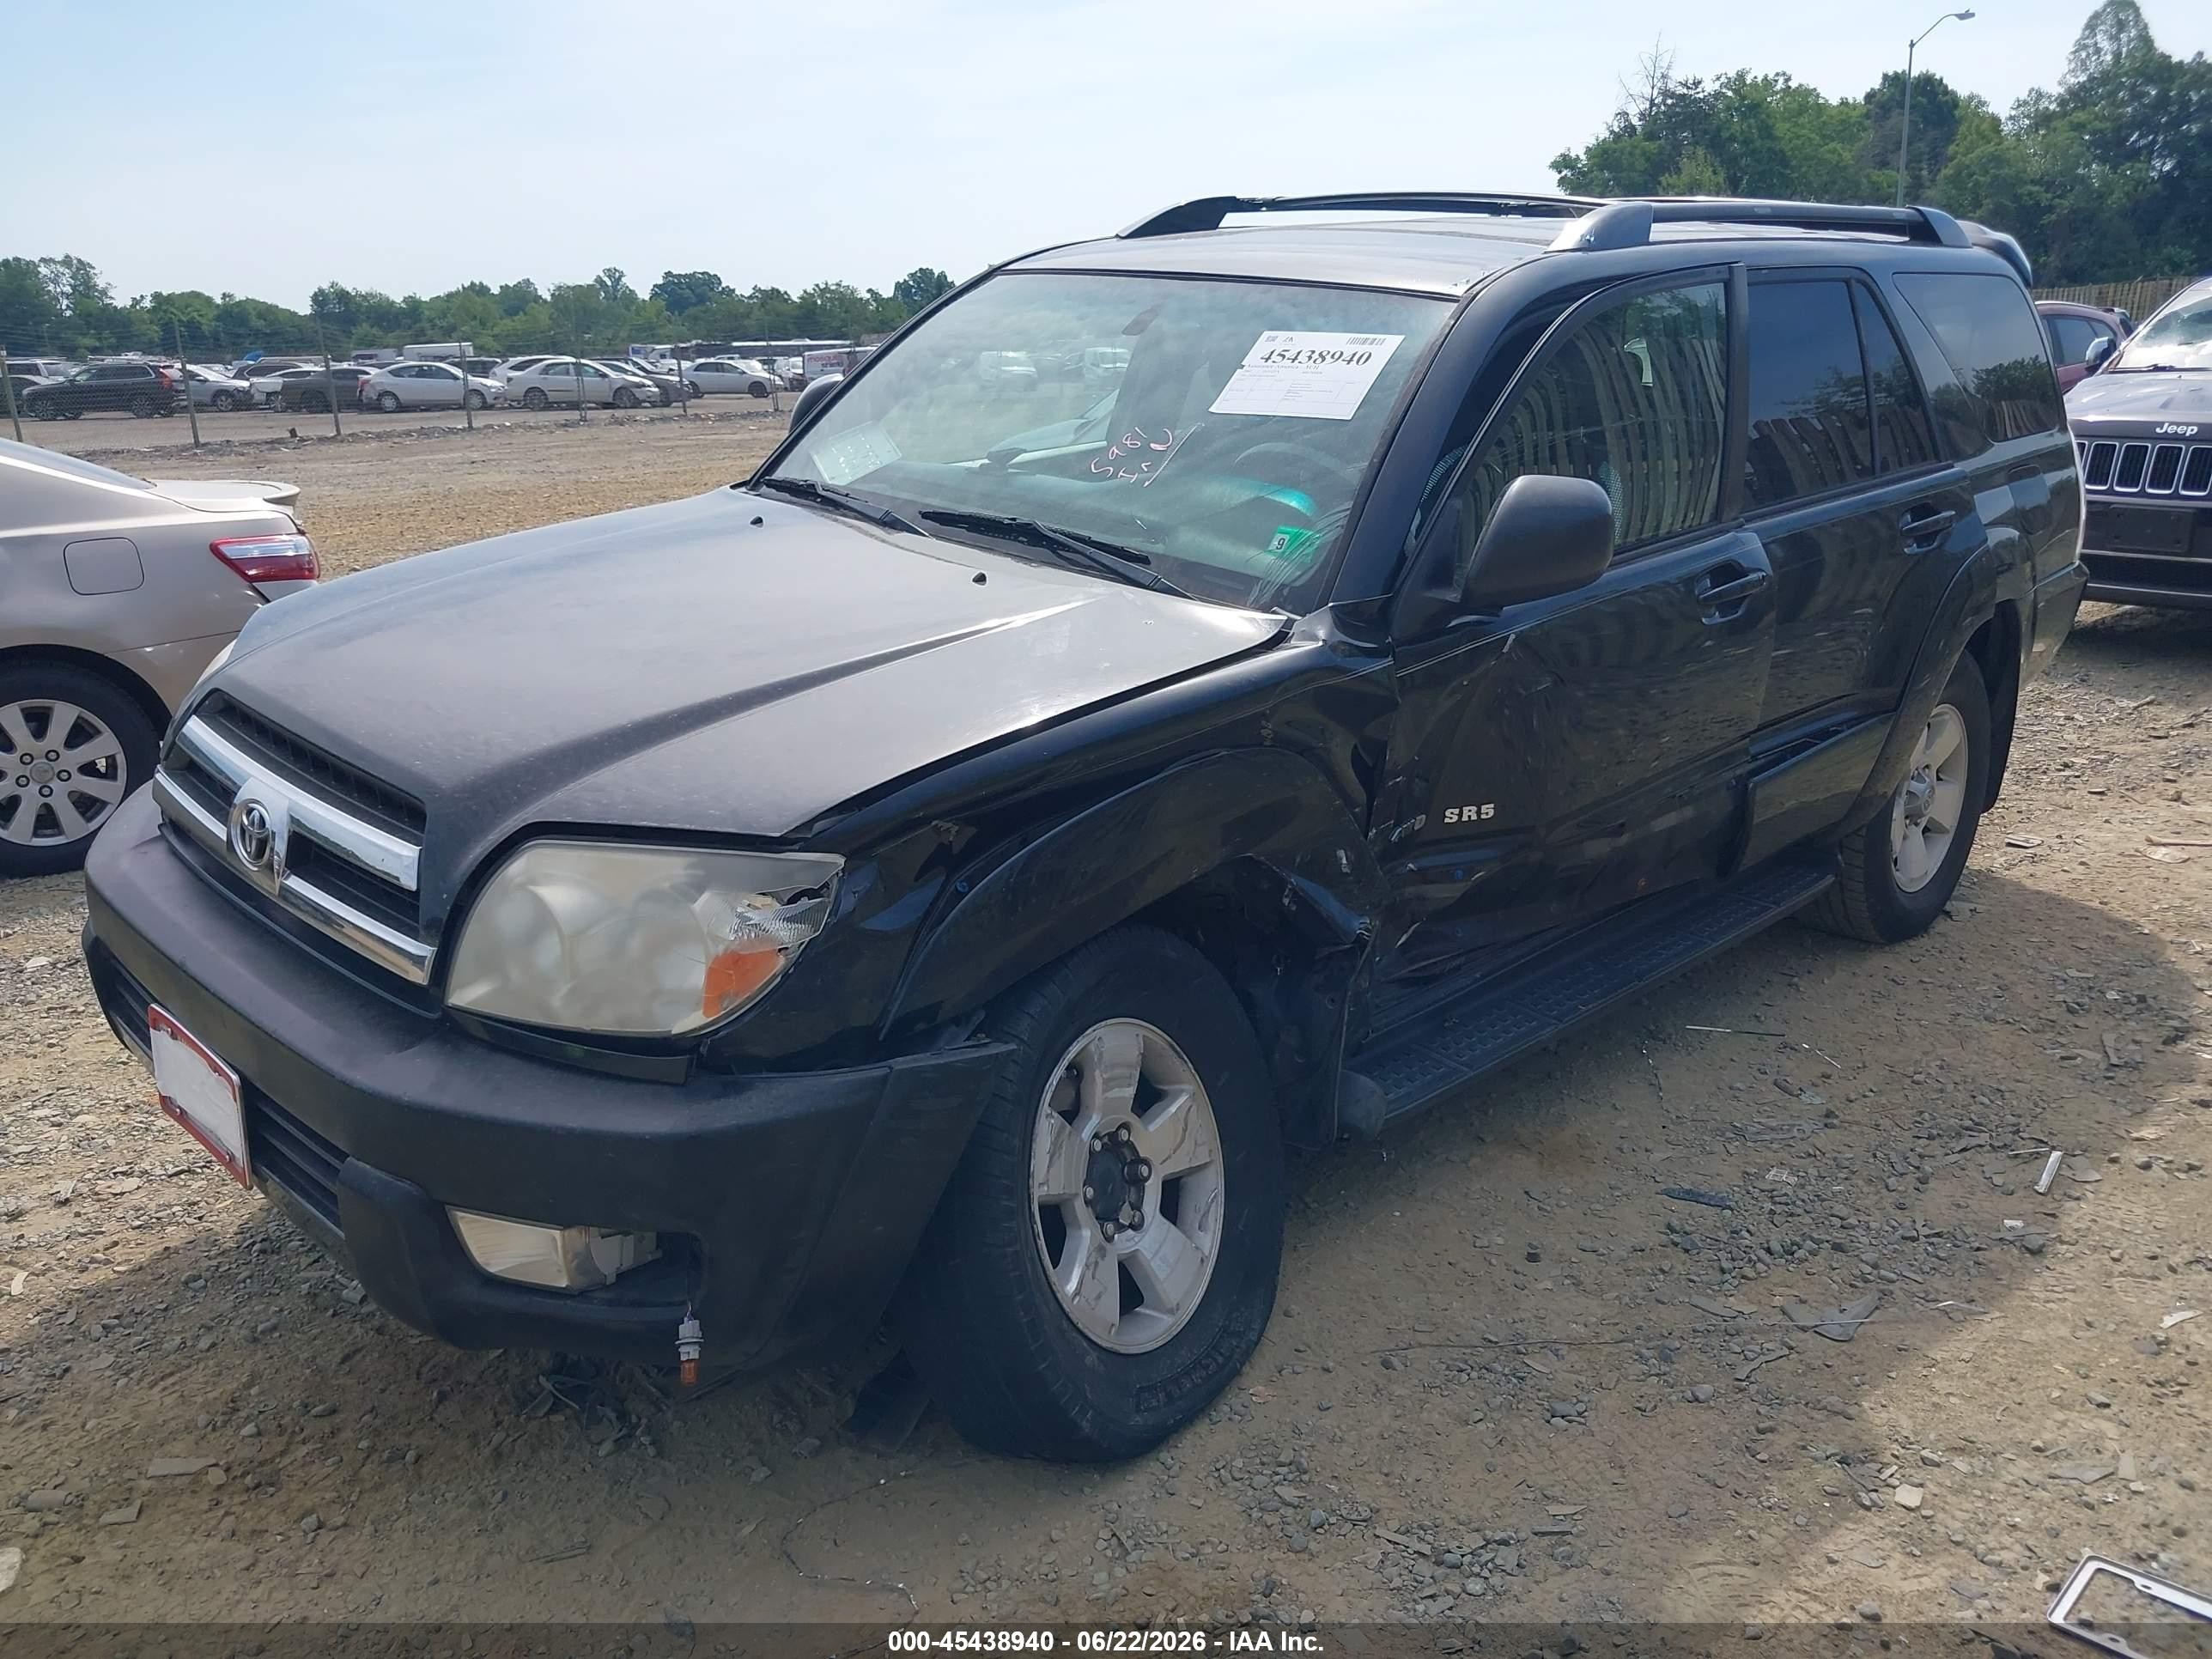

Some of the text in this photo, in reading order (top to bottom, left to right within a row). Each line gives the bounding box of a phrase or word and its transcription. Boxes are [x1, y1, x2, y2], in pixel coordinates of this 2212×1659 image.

[1260, 348, 1372, 366] 45438940
[2154, 422, 2198, 437] Jeep
[1275, 538, 1285, 550] 9
[1443, 803, 1496, 823] SR5
